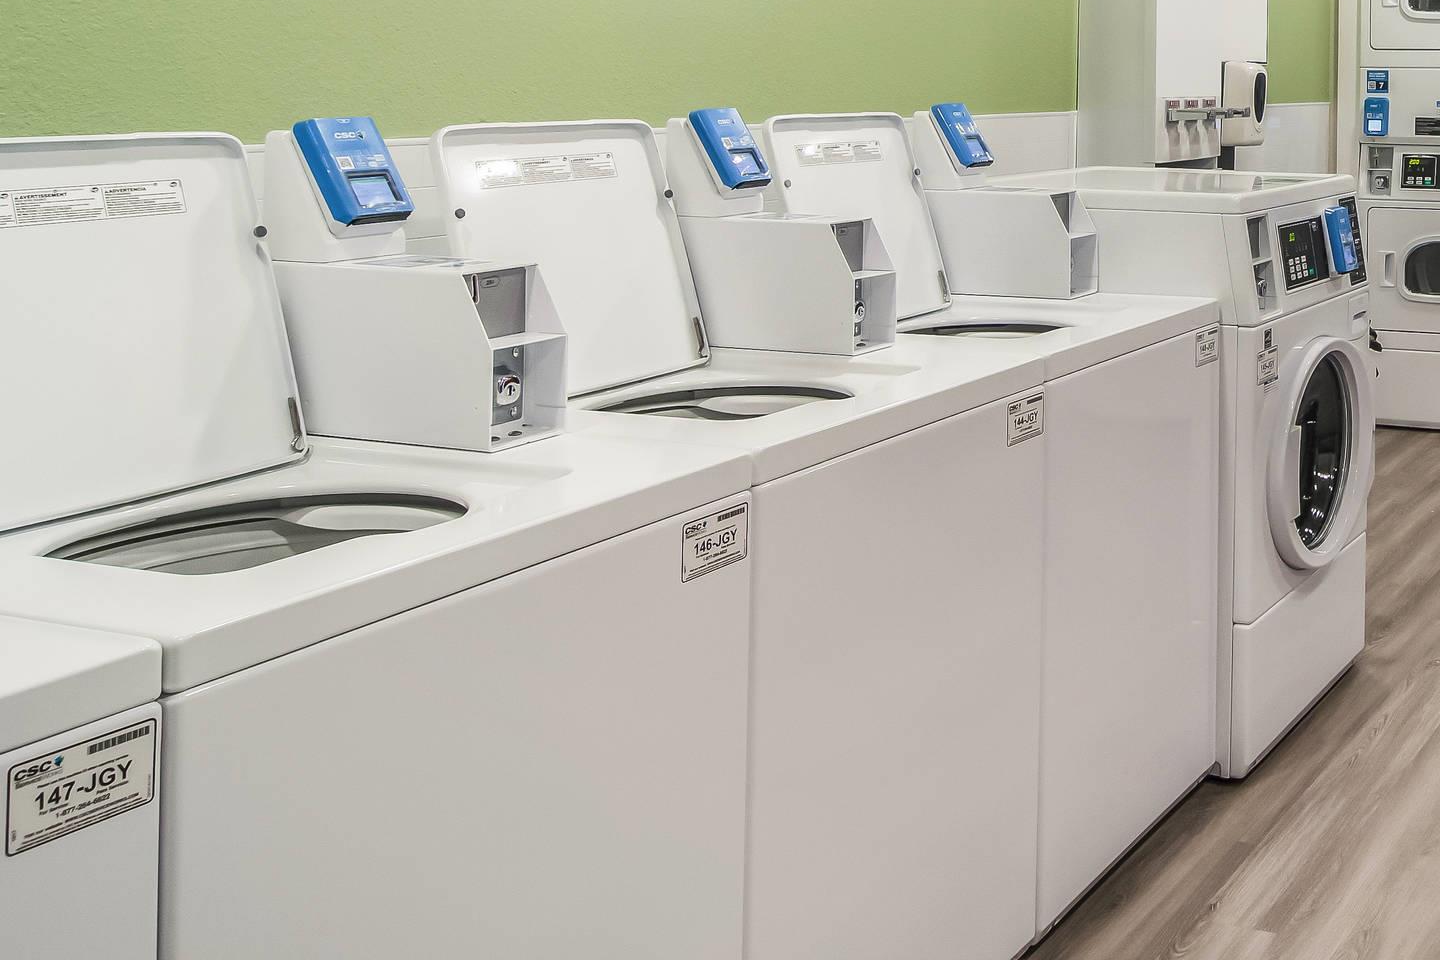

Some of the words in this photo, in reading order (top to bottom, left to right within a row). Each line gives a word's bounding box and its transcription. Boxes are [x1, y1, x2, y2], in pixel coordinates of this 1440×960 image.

[334, 131, 357, 139] CSC
[685, 523, 702, 535] CSC
[693, 527, 738, 555] 146-JGY
[14, 760, 52, 782] CSC
[34, 759, 133, 811] 147-JGY
